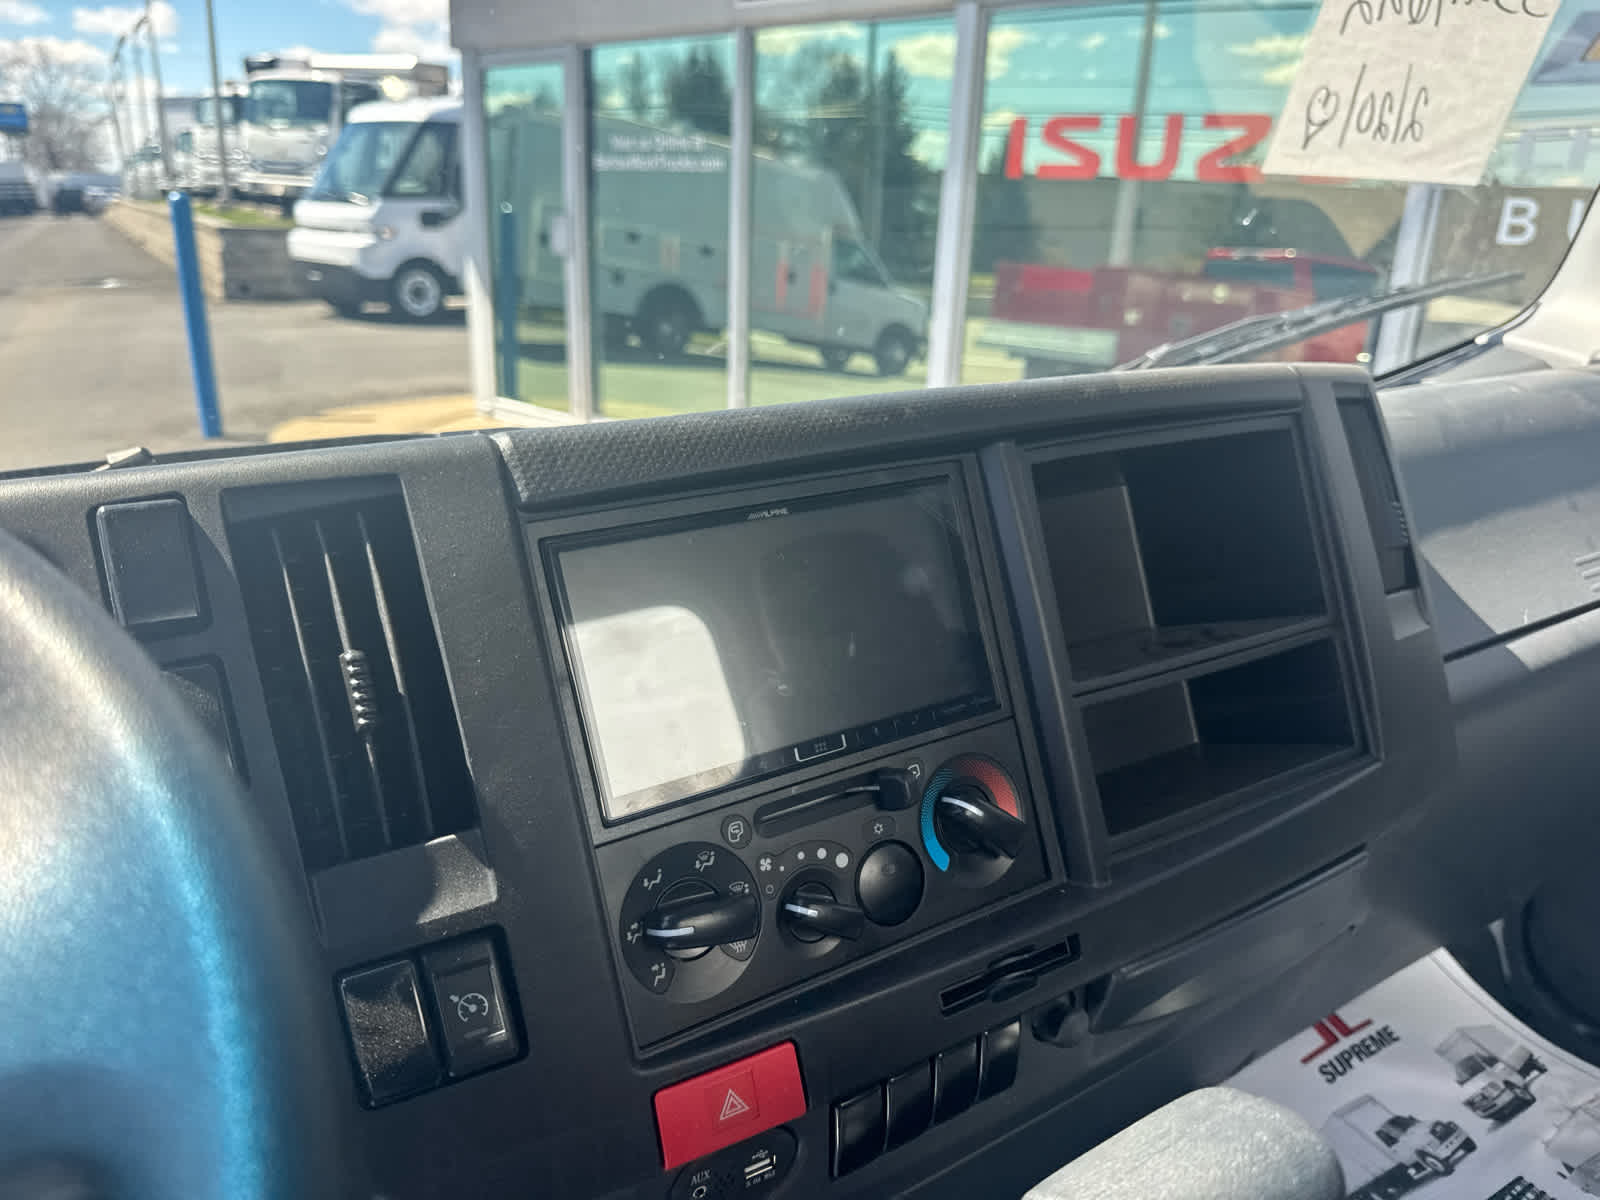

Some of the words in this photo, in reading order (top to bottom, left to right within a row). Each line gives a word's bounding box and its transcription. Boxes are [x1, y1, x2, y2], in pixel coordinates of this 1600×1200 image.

[1004, 113, 1348, 184] ISUZ
[1318, 1025, 1400, 1084] SUPREME
[690, 1169, 711, 1186] AUX
